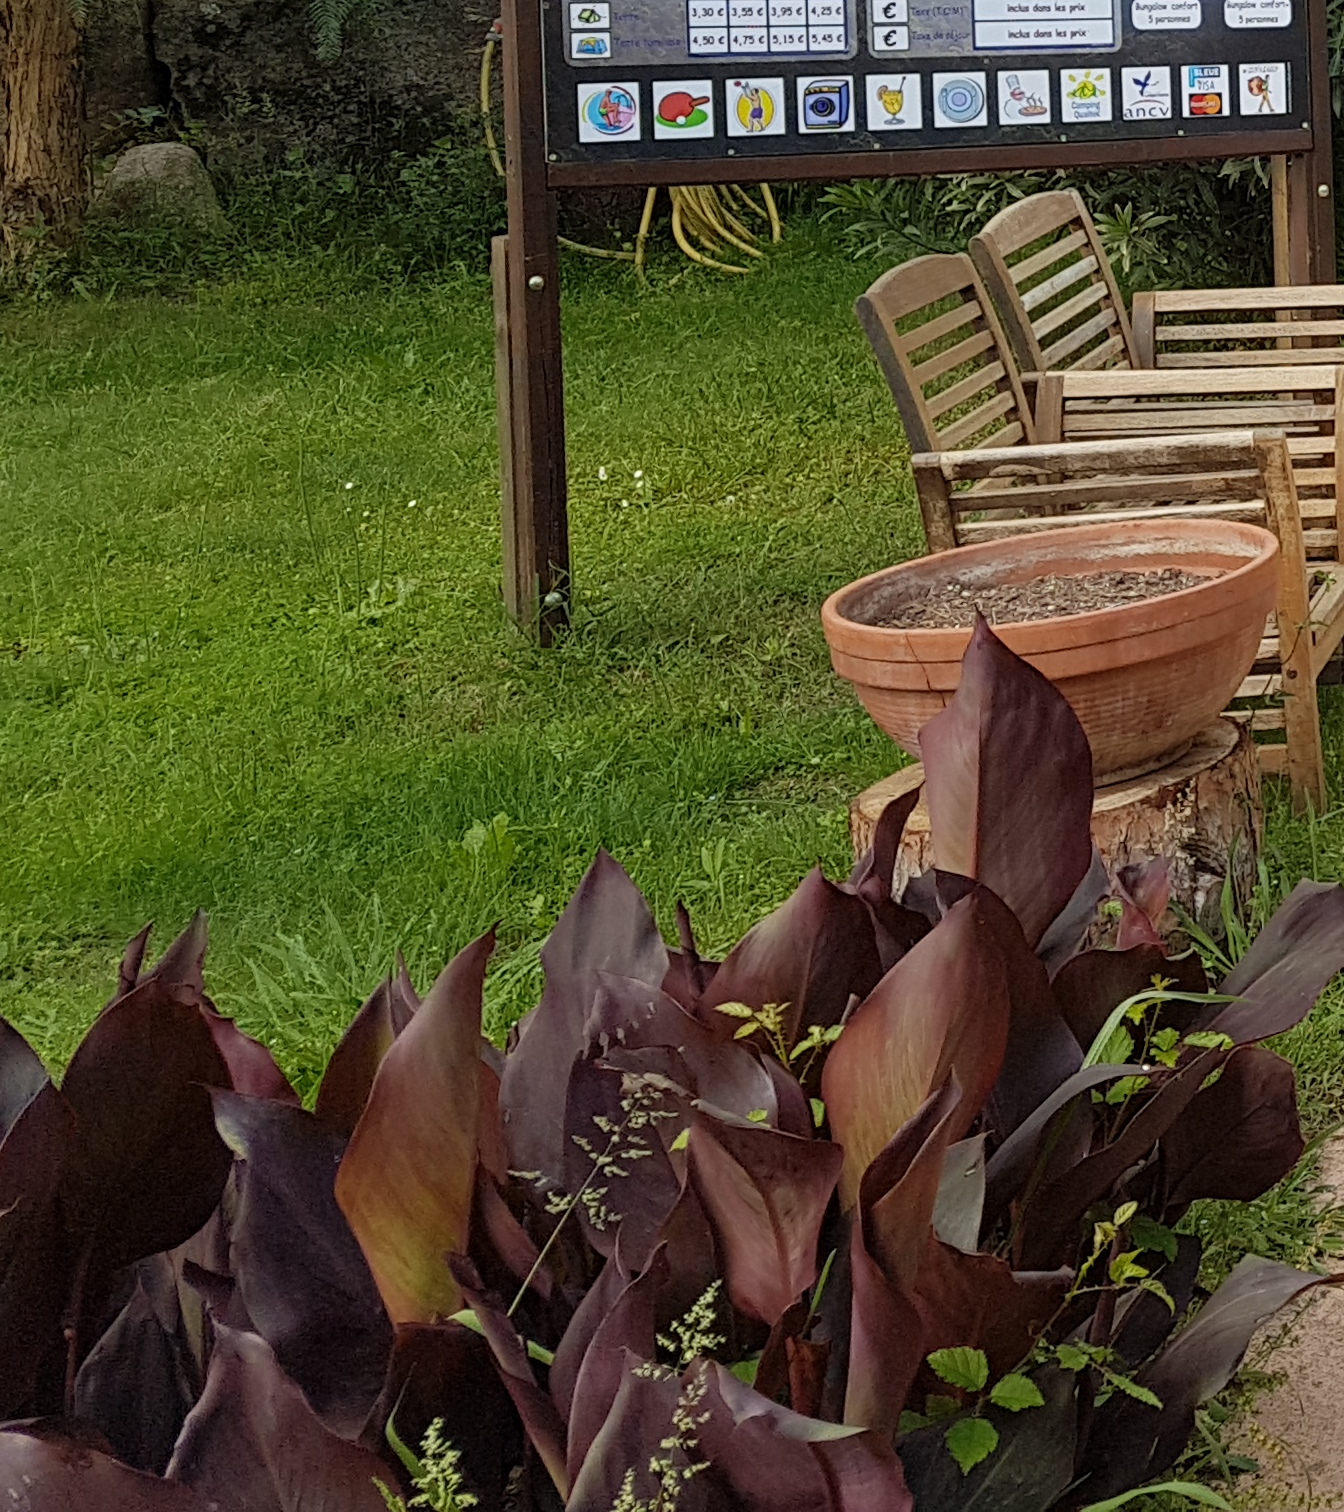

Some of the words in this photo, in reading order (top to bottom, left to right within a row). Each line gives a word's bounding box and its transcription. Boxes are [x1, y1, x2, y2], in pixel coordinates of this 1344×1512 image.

[692, 8, 714, 18] 3,30
[732, 7, 753, 18] 3,55
[771, 7, 793, 18] 3,95
[811, 6, 832, 17] 4,25
[1032, 3, 1051, 12] dans
[1054, 1, 1066, 12] les
[1069, 3, 1086, 14] prix
[812, 34, 833, 44] 5,45
[1033, 29, 1052, 38] dans
[1055, 28, 1067, 38] les
[1070, 28, 1086, 39] prix
[693, 36, 715, 46] 4,50
[733, 35, 755, 46] 4,75
[772, 35, 794, 45] 5,15
[1197, 80, 1215, 90] VISA
[1124, 106, 1169, 119] ancv
